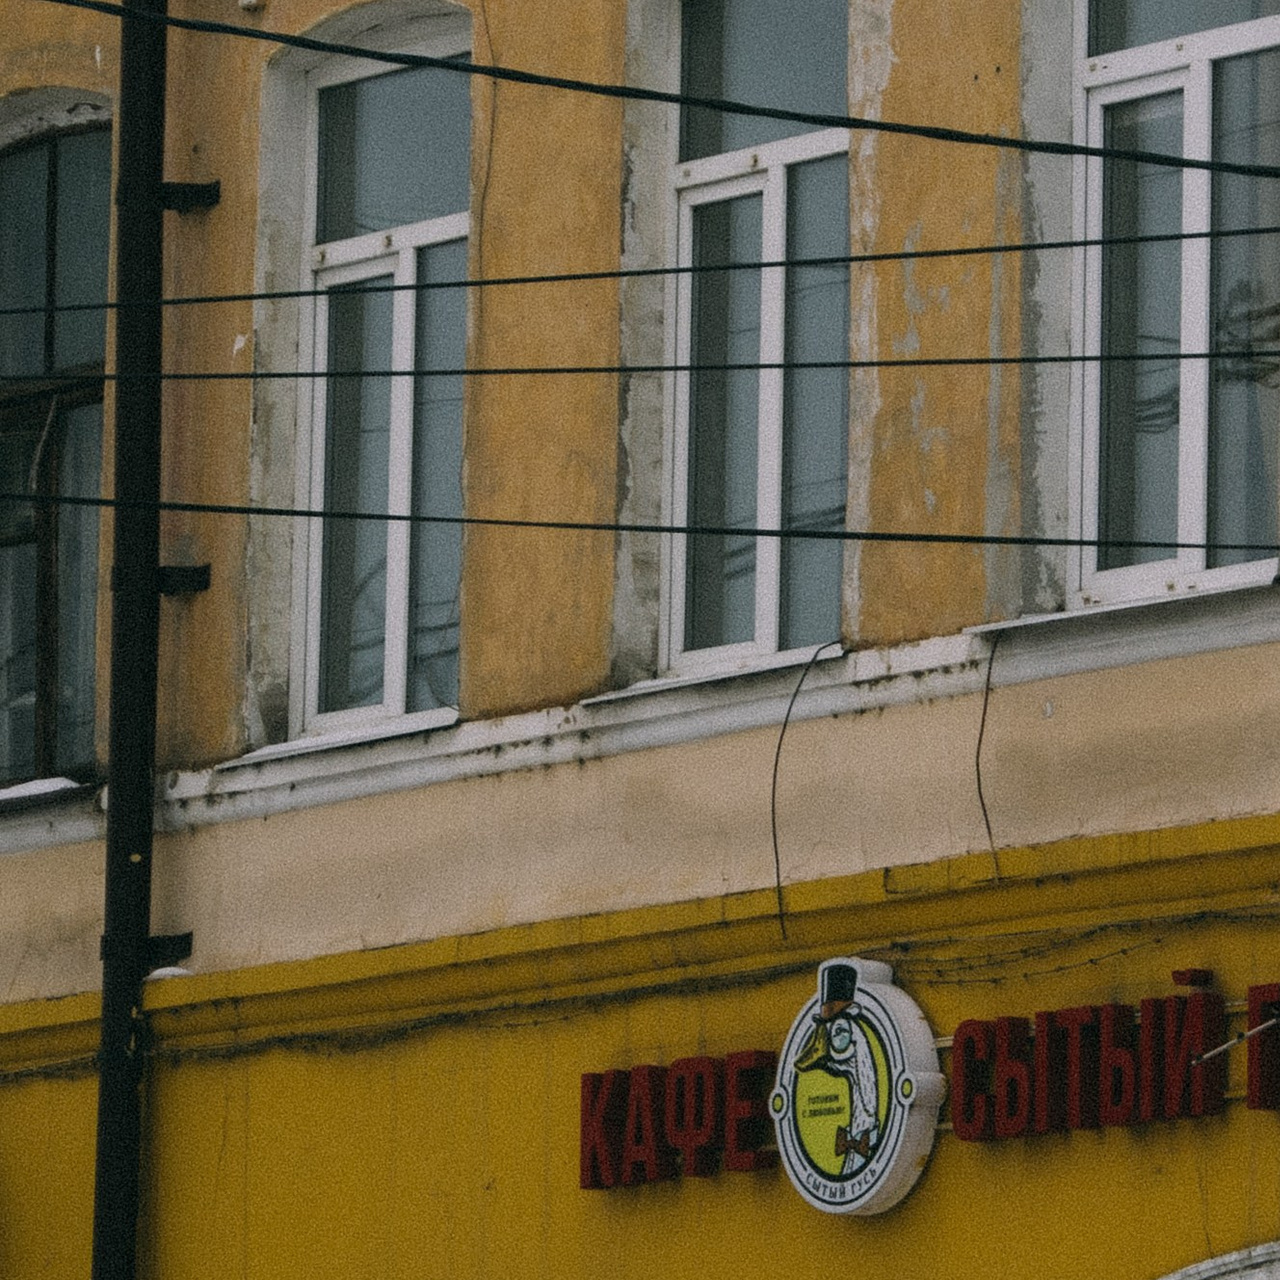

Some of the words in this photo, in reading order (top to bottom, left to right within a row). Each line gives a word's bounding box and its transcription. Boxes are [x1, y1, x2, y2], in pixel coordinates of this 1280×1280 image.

[580, 1050, 760, 1189] КАФЕ
[953, 969, 1208, 1141] СЫТЫЙ
[806, 1172, 846, 1199] СЫТЫЙ
[851, 1167, 877, 1195] ГУСЬ
